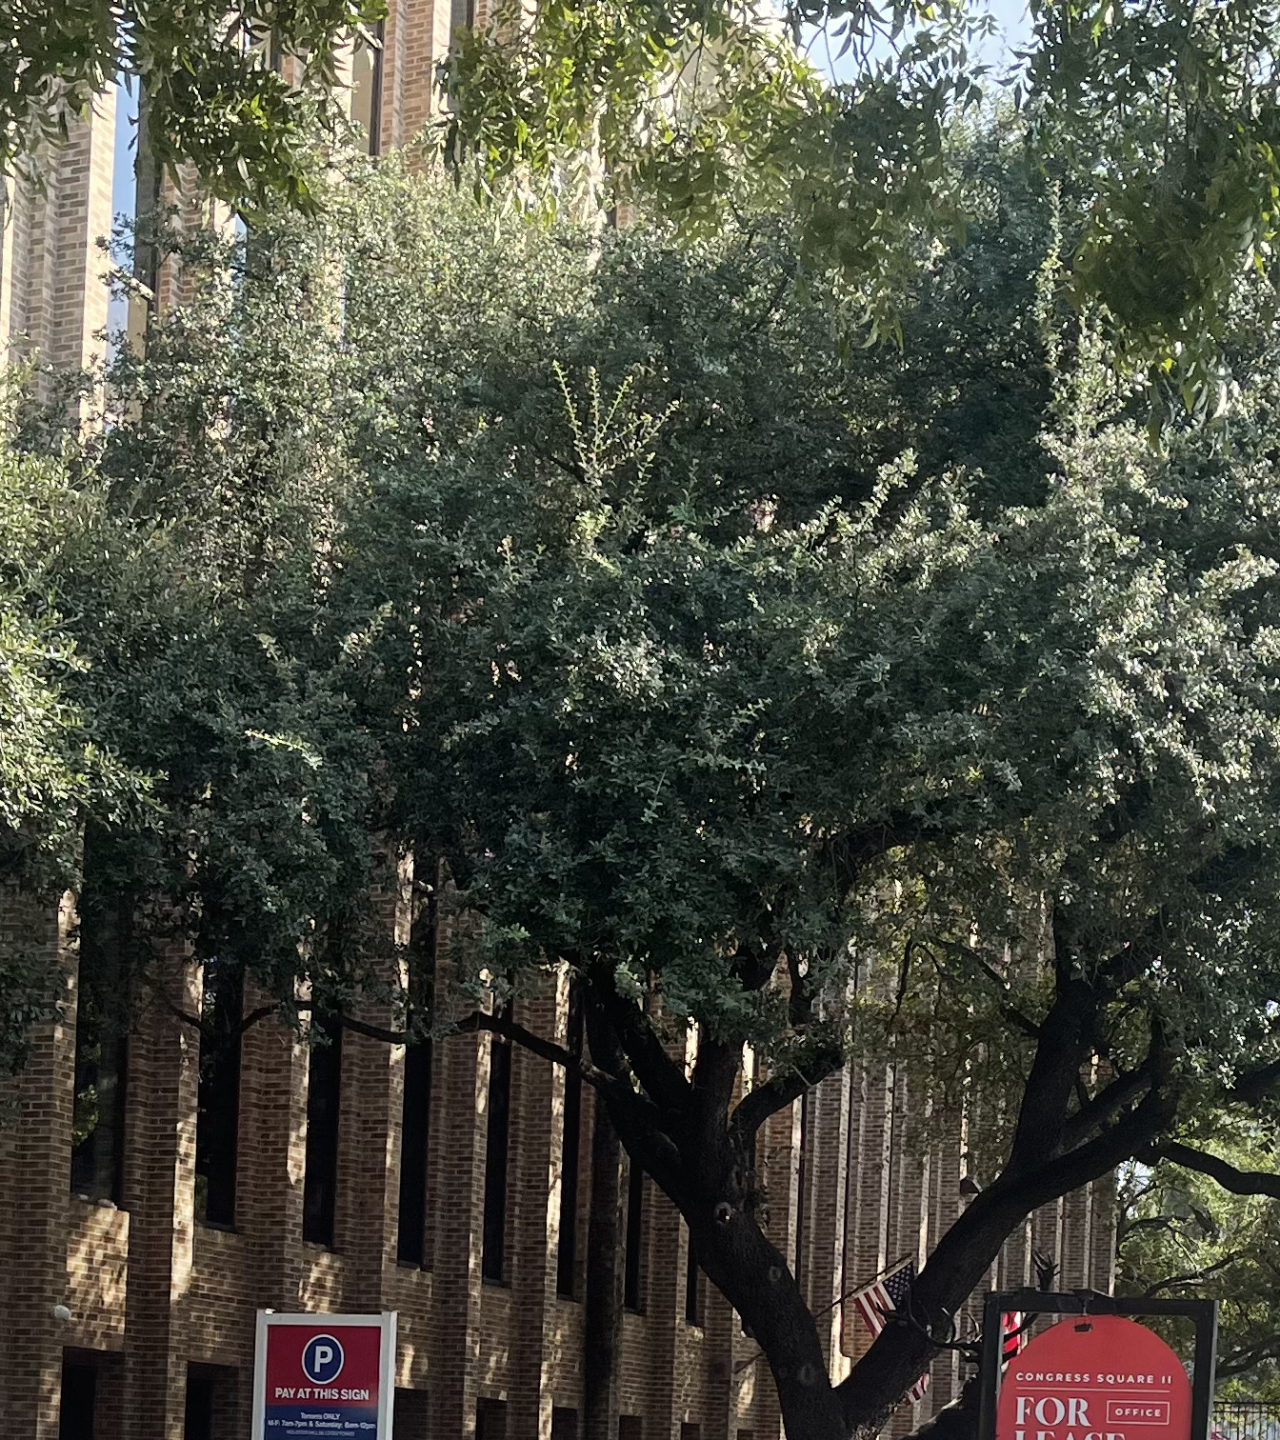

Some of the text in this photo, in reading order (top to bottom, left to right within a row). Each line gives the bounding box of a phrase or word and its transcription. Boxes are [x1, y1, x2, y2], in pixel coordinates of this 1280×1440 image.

[314, 1346, 333, 1373] P
[1015, 1372, 1090, 1383] CONGRESS
[1097, 1374, 1154, 1384] SQUARE
[275, 1387, 369, 1400] PAY AT THIS SIGN
[1015, 1397, 1092, 1427] FOR
[1115, 1408, 1161, 1417] OFFICE
